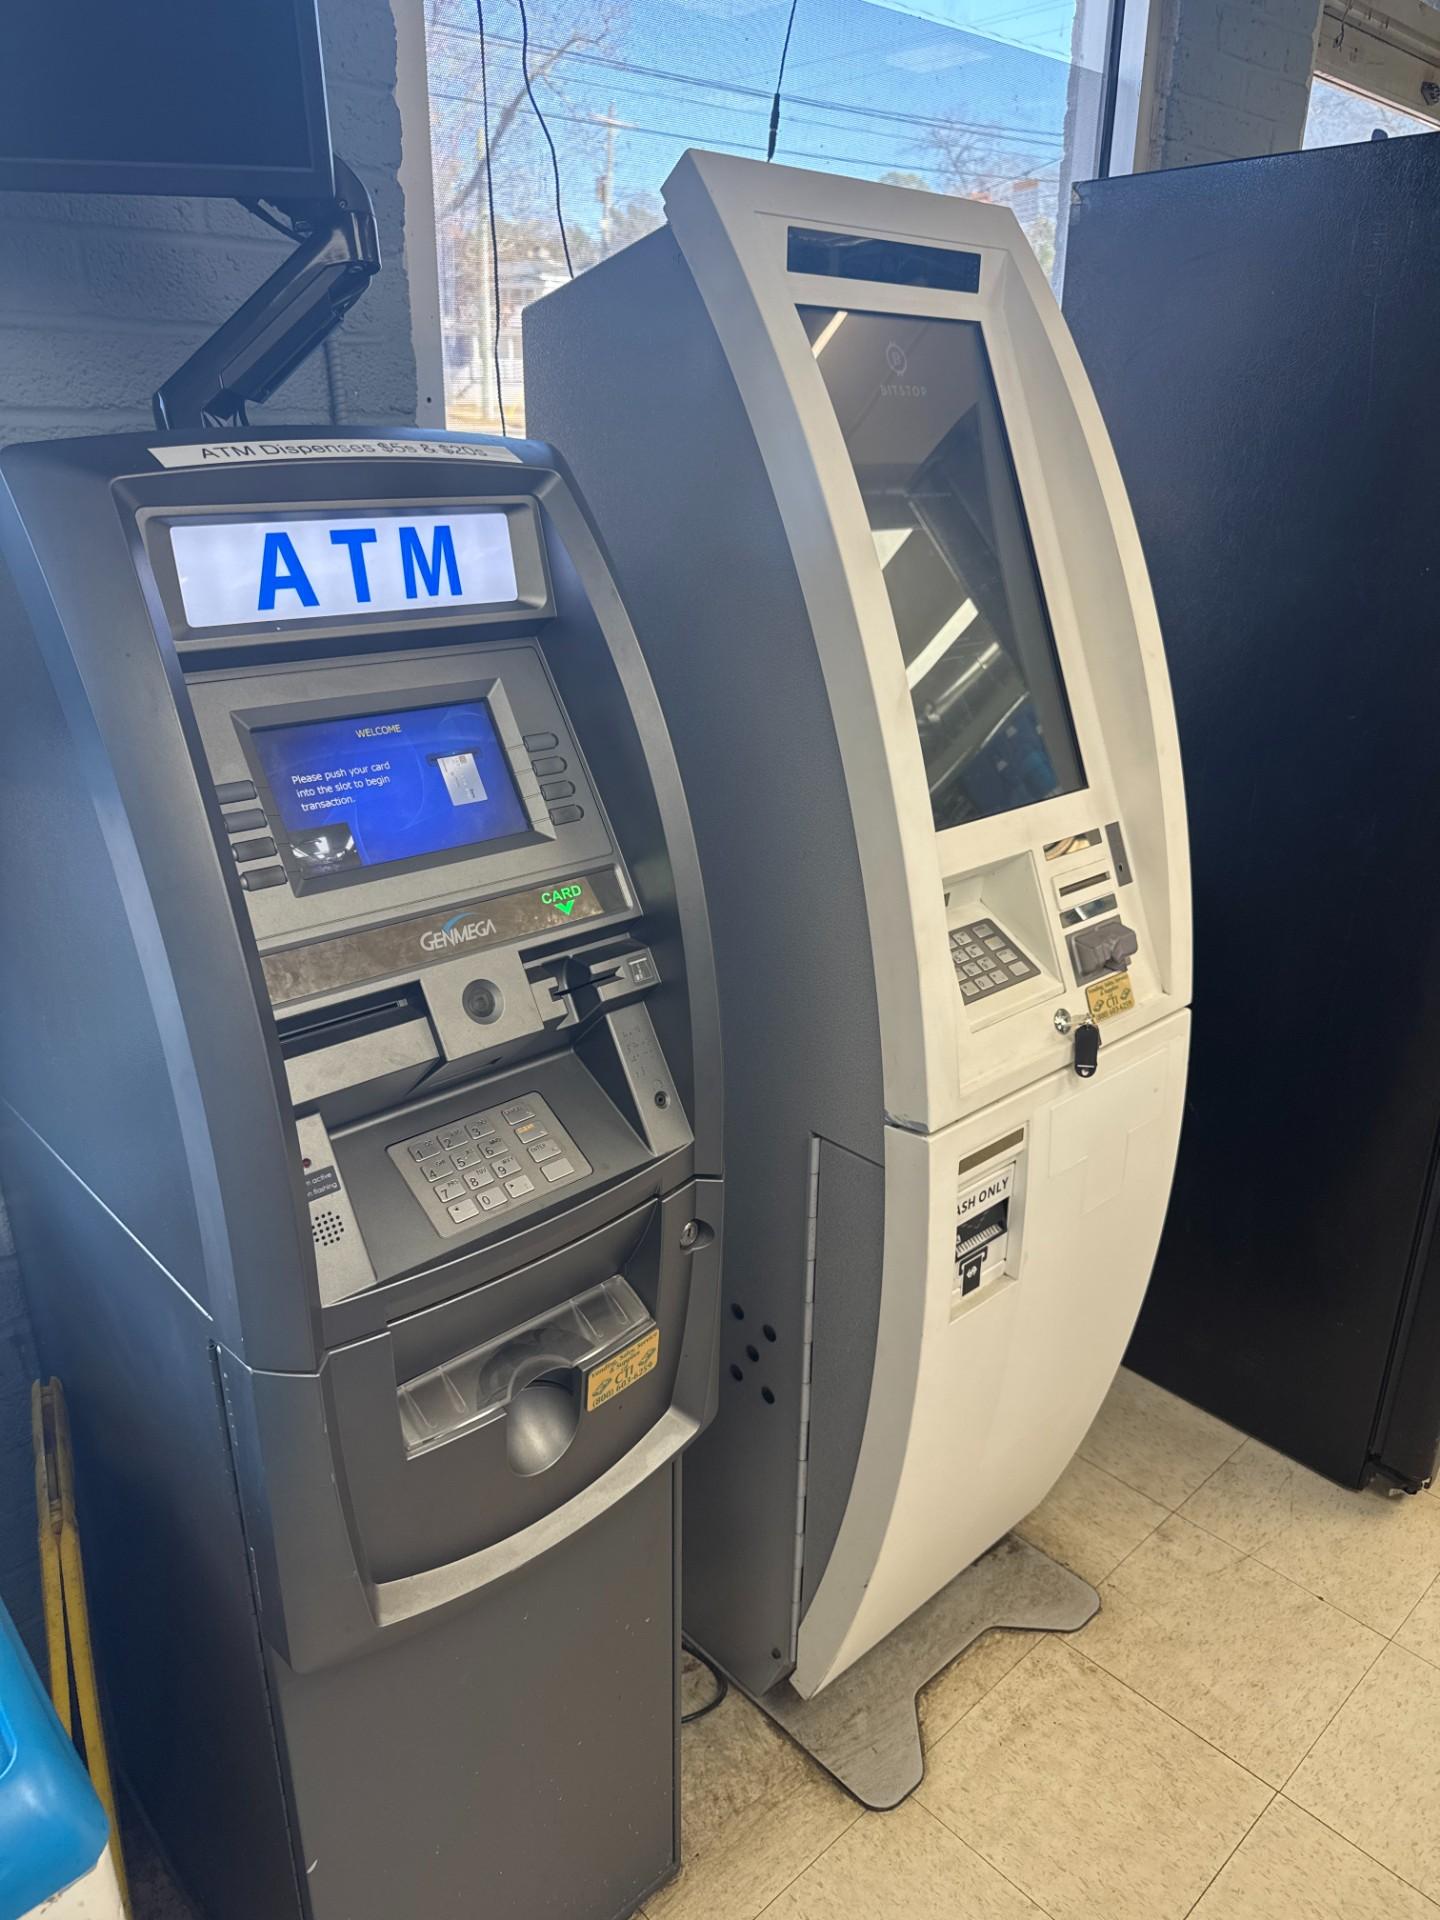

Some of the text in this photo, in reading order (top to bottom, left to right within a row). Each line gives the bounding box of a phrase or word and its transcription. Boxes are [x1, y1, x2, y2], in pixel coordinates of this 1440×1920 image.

[201, 441, 488, 460] ATM Dispenses $5s & $20s
[257, 525, 463, 611] ATM
[355, 724, 402, 739] WELCOME
[291, 761, 391, 785] Please push your card
[295, 775, 391, 798] into the slot to begin
[300, 795, 357, 813] transaction.
[541, 884, 582, 905] CARD
[420, 919, 496, 951] GENMEGA
[472, 1127, 480, 1137] 3
[443, 1138, 451, 1148] 2
[416, 1150, 423, 1159] 1
[485, 1147, 493, 1156] 6
[457, 1158, 466, 1168] 5
[429, 1170, 437, 1178] 4
[498, 1165, 507, 1175] 9
[312, 1172, 331, 1184] active
[470, 1177, 479, 1187] 8
[441, 1189, 449, 1199] 7
[979, 1176, 1009, 1203] ONLY
[482, 1195, 491, 1205] 0
[615, 1364, 634, 1384] CTI
